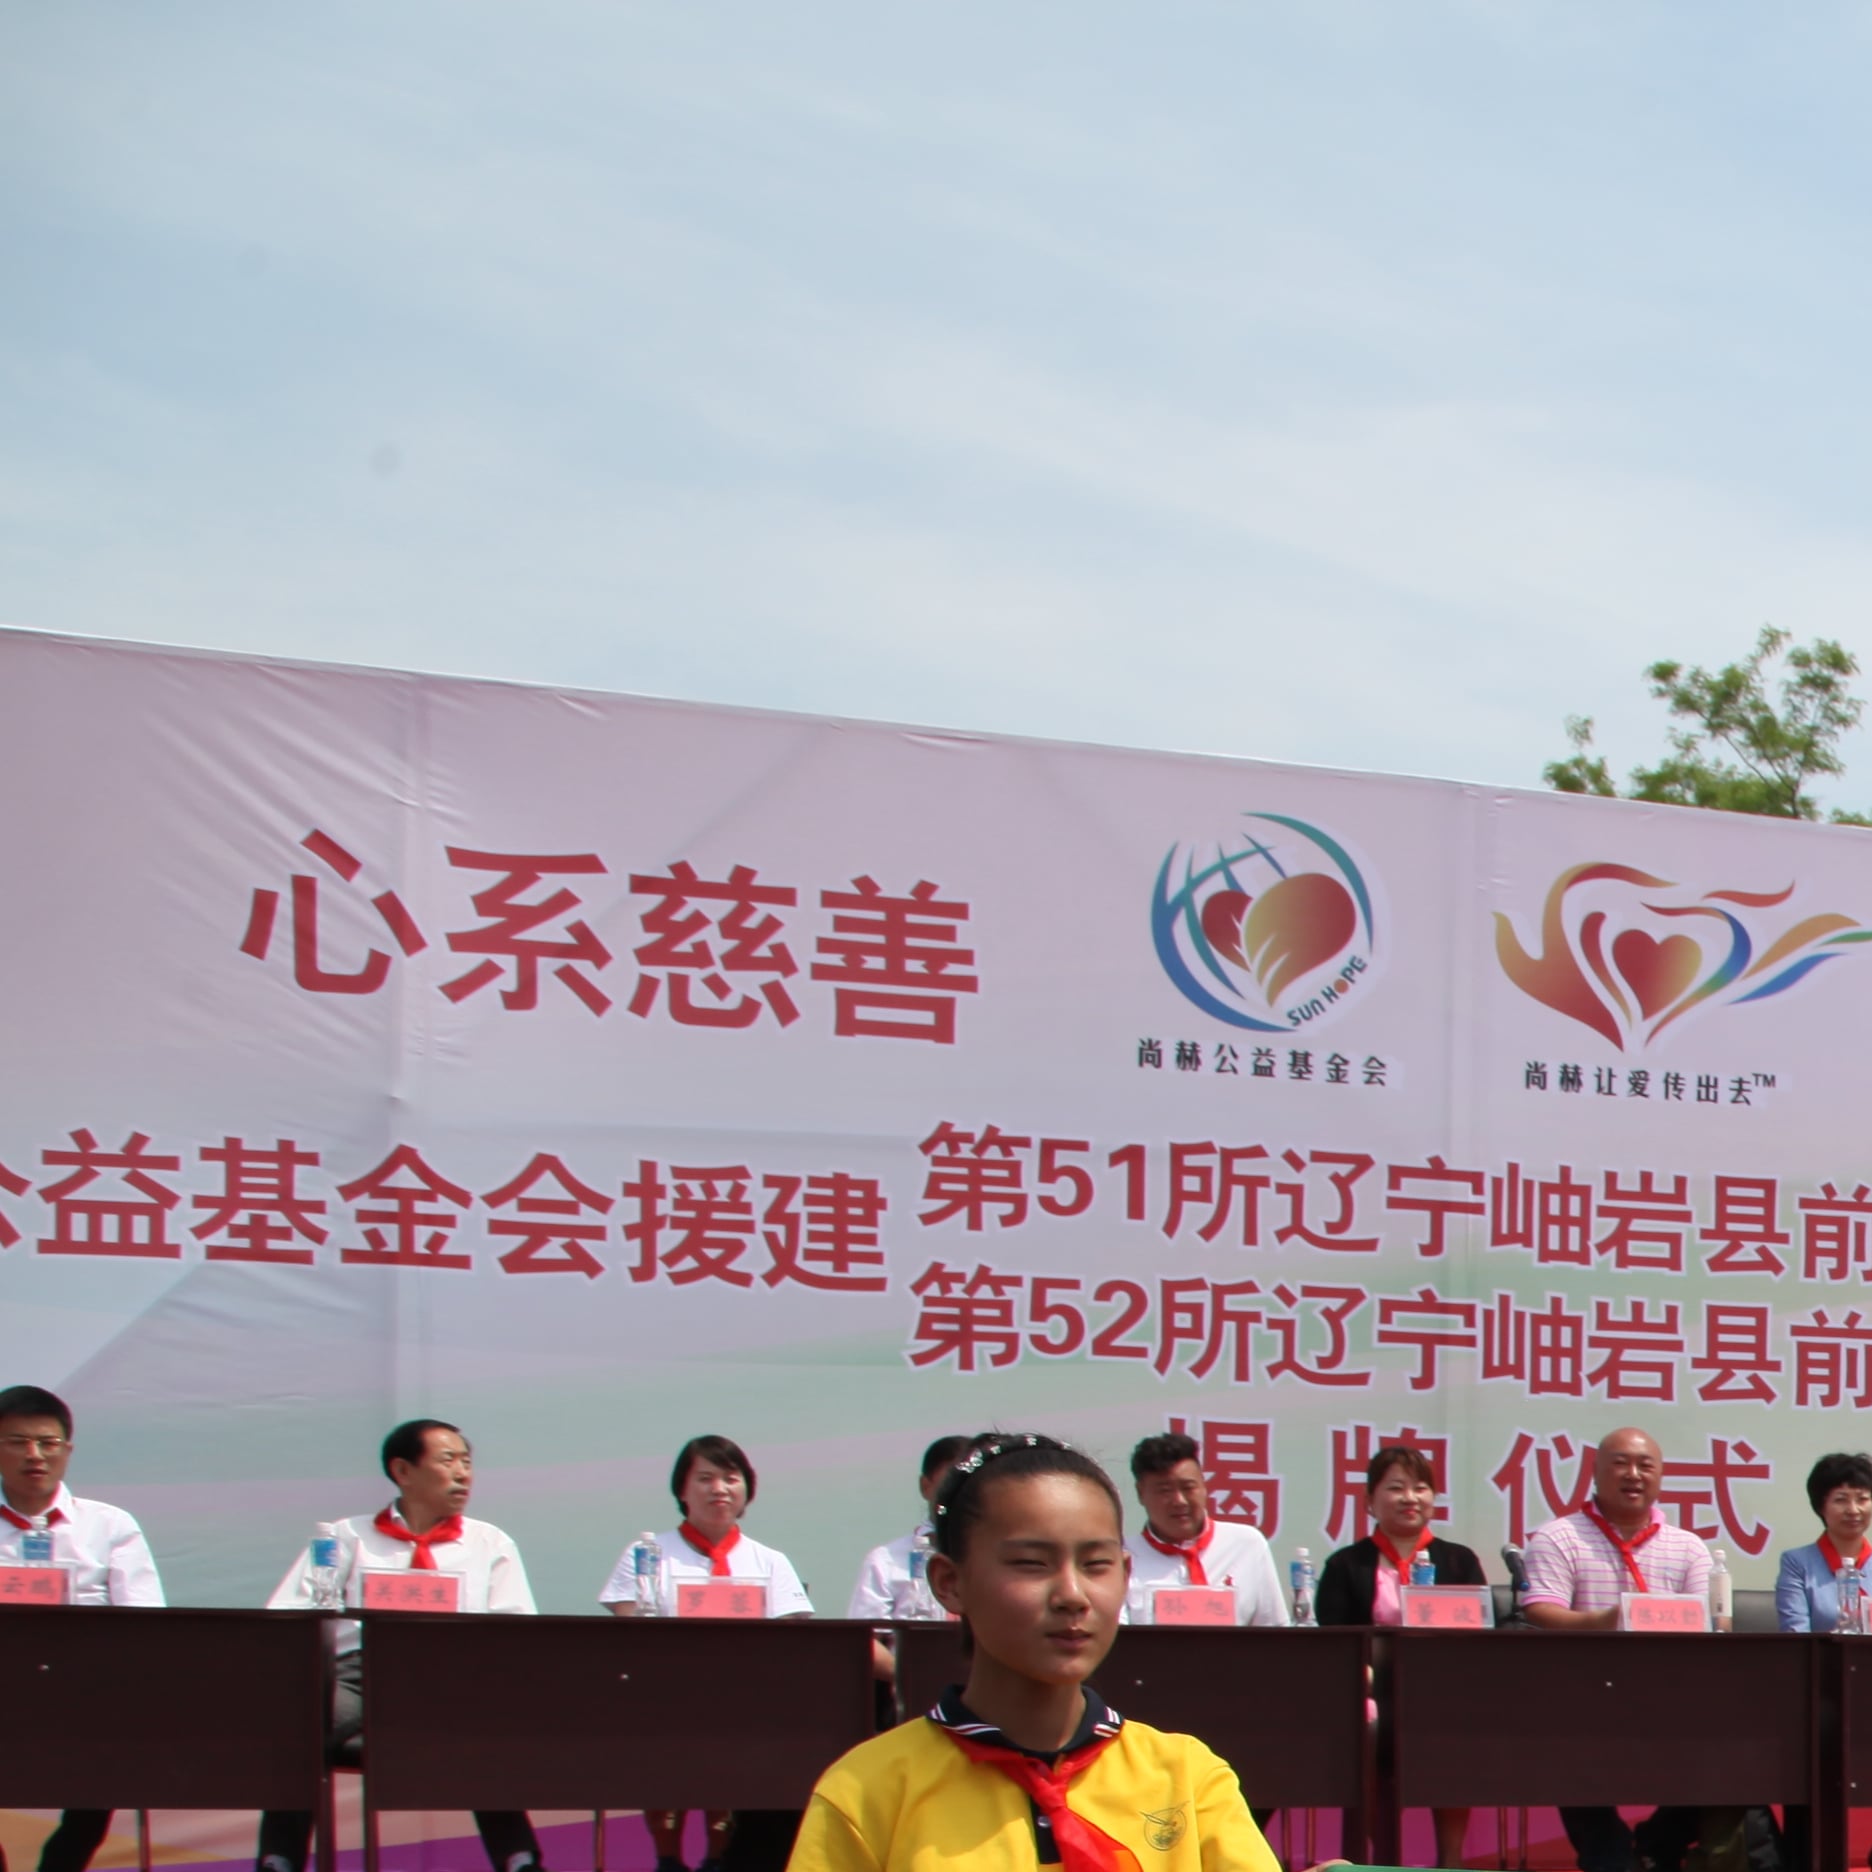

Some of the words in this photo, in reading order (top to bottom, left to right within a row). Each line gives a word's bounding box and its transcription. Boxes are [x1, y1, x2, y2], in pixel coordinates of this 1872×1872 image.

[240, 828, 979, 1045] 心系慈善
[1138, 1037, 1387, 1087] 尚赫公益基金会
